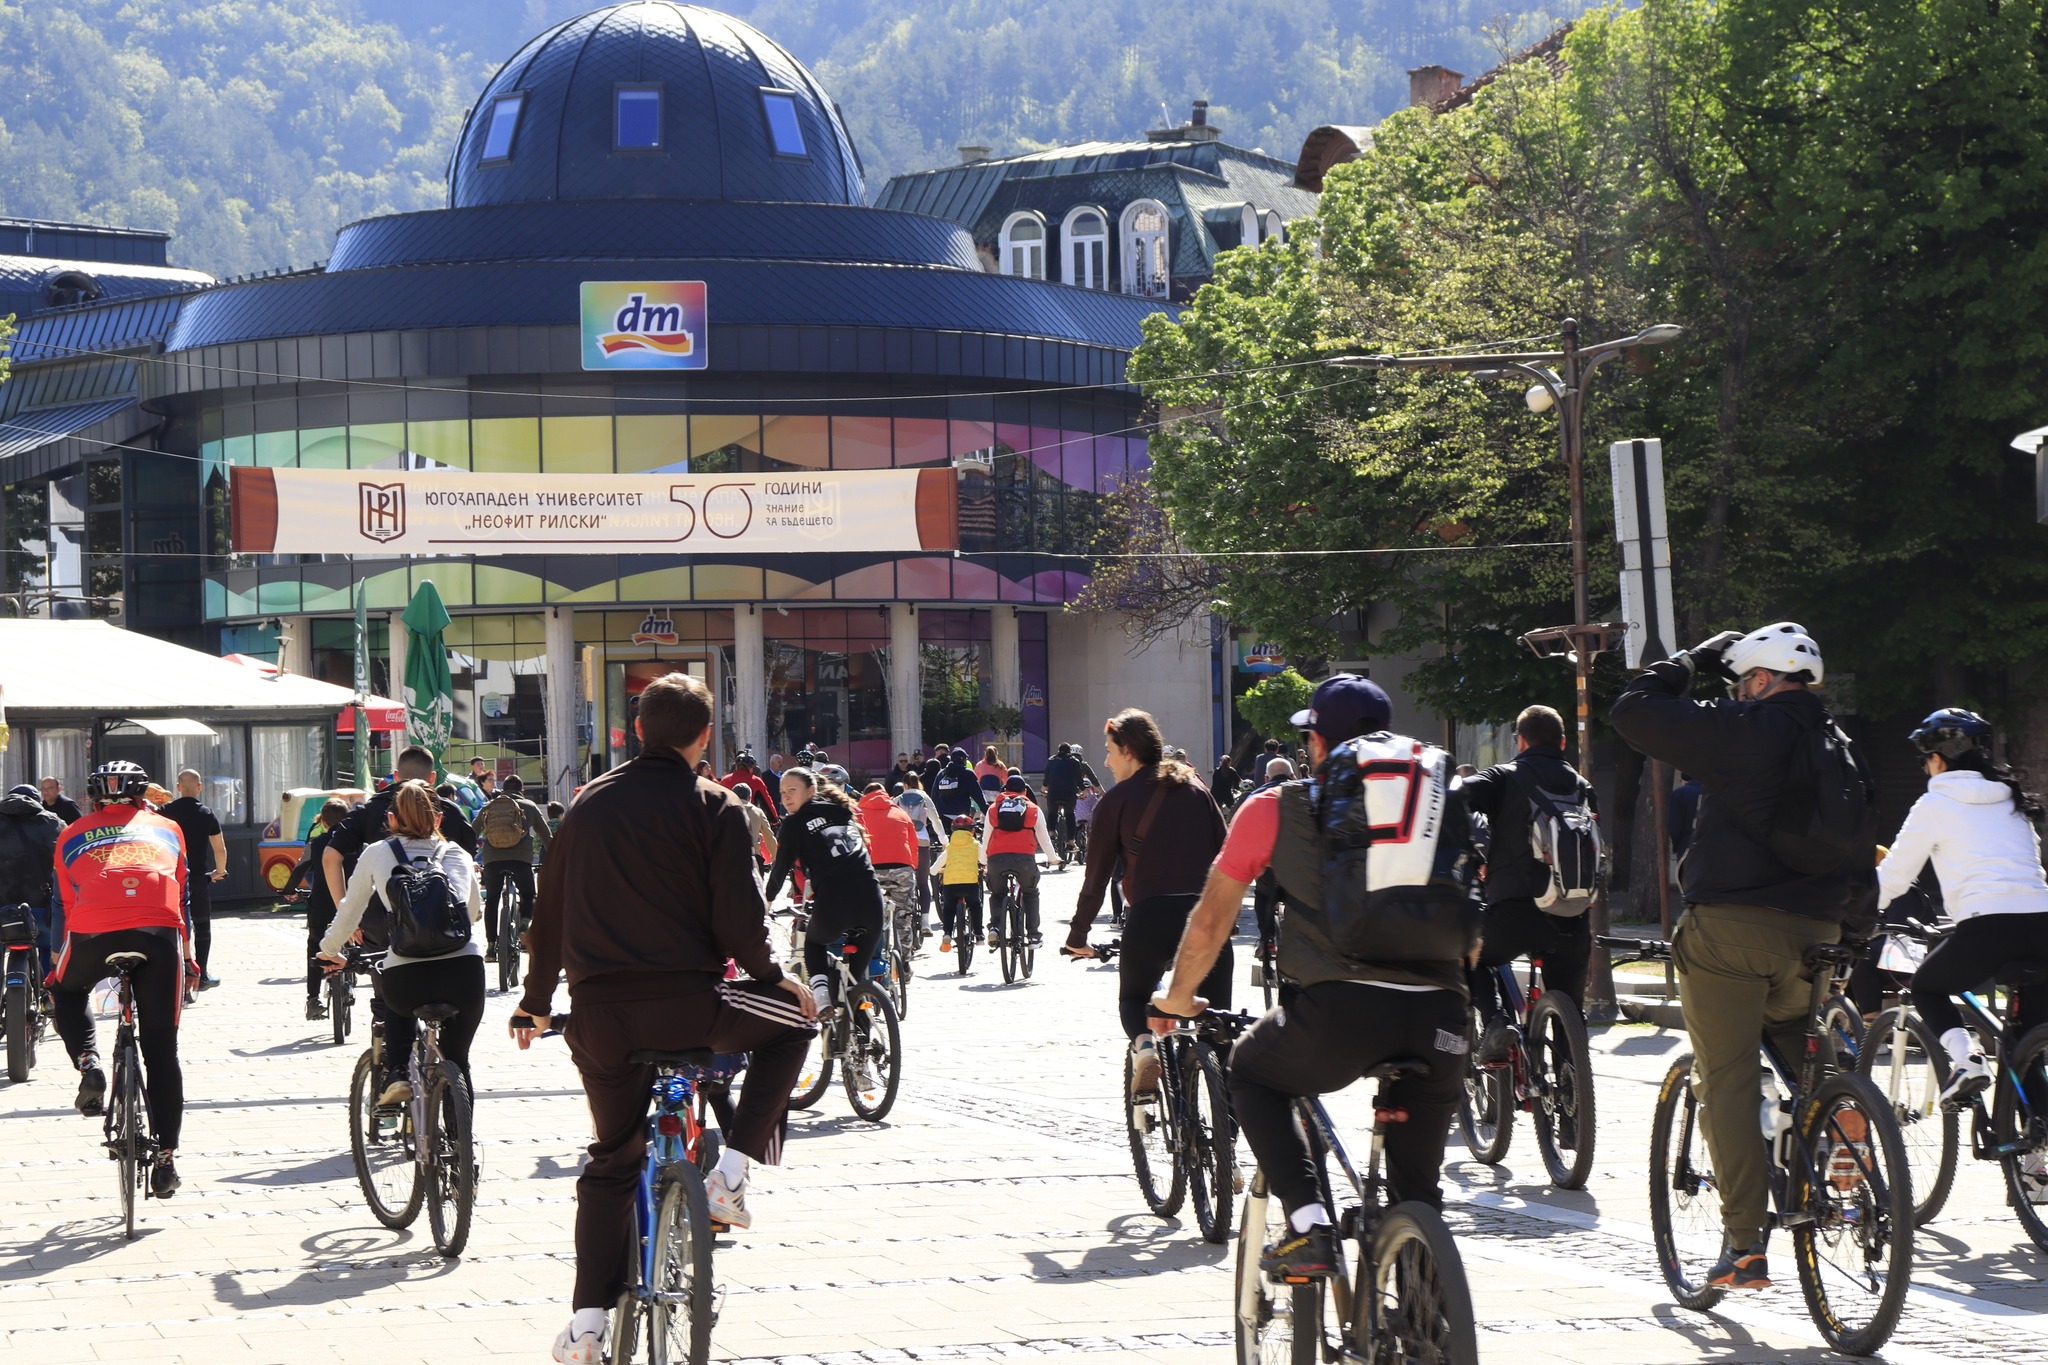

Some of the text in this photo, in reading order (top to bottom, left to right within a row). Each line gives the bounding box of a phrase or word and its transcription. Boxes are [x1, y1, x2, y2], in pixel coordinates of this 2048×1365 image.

[617, 296, 680, 332] dm
[764, 481, 823, 496] ГОДИНИ
[425, 491, 643, 507] ЮГОЗАПАДЕН УНИВЕРСИТЕТ
[670, 482, 756, 543] 50
[765, 503, 805, 514] ЗНАНИЕ
[464, 513, 608, 530] „НЕОФИТ РИЛСКИ“
[765, 516, 834, 527] ЗА БЪДЕЩЕТО
[641, 615, 672, 634] dm
